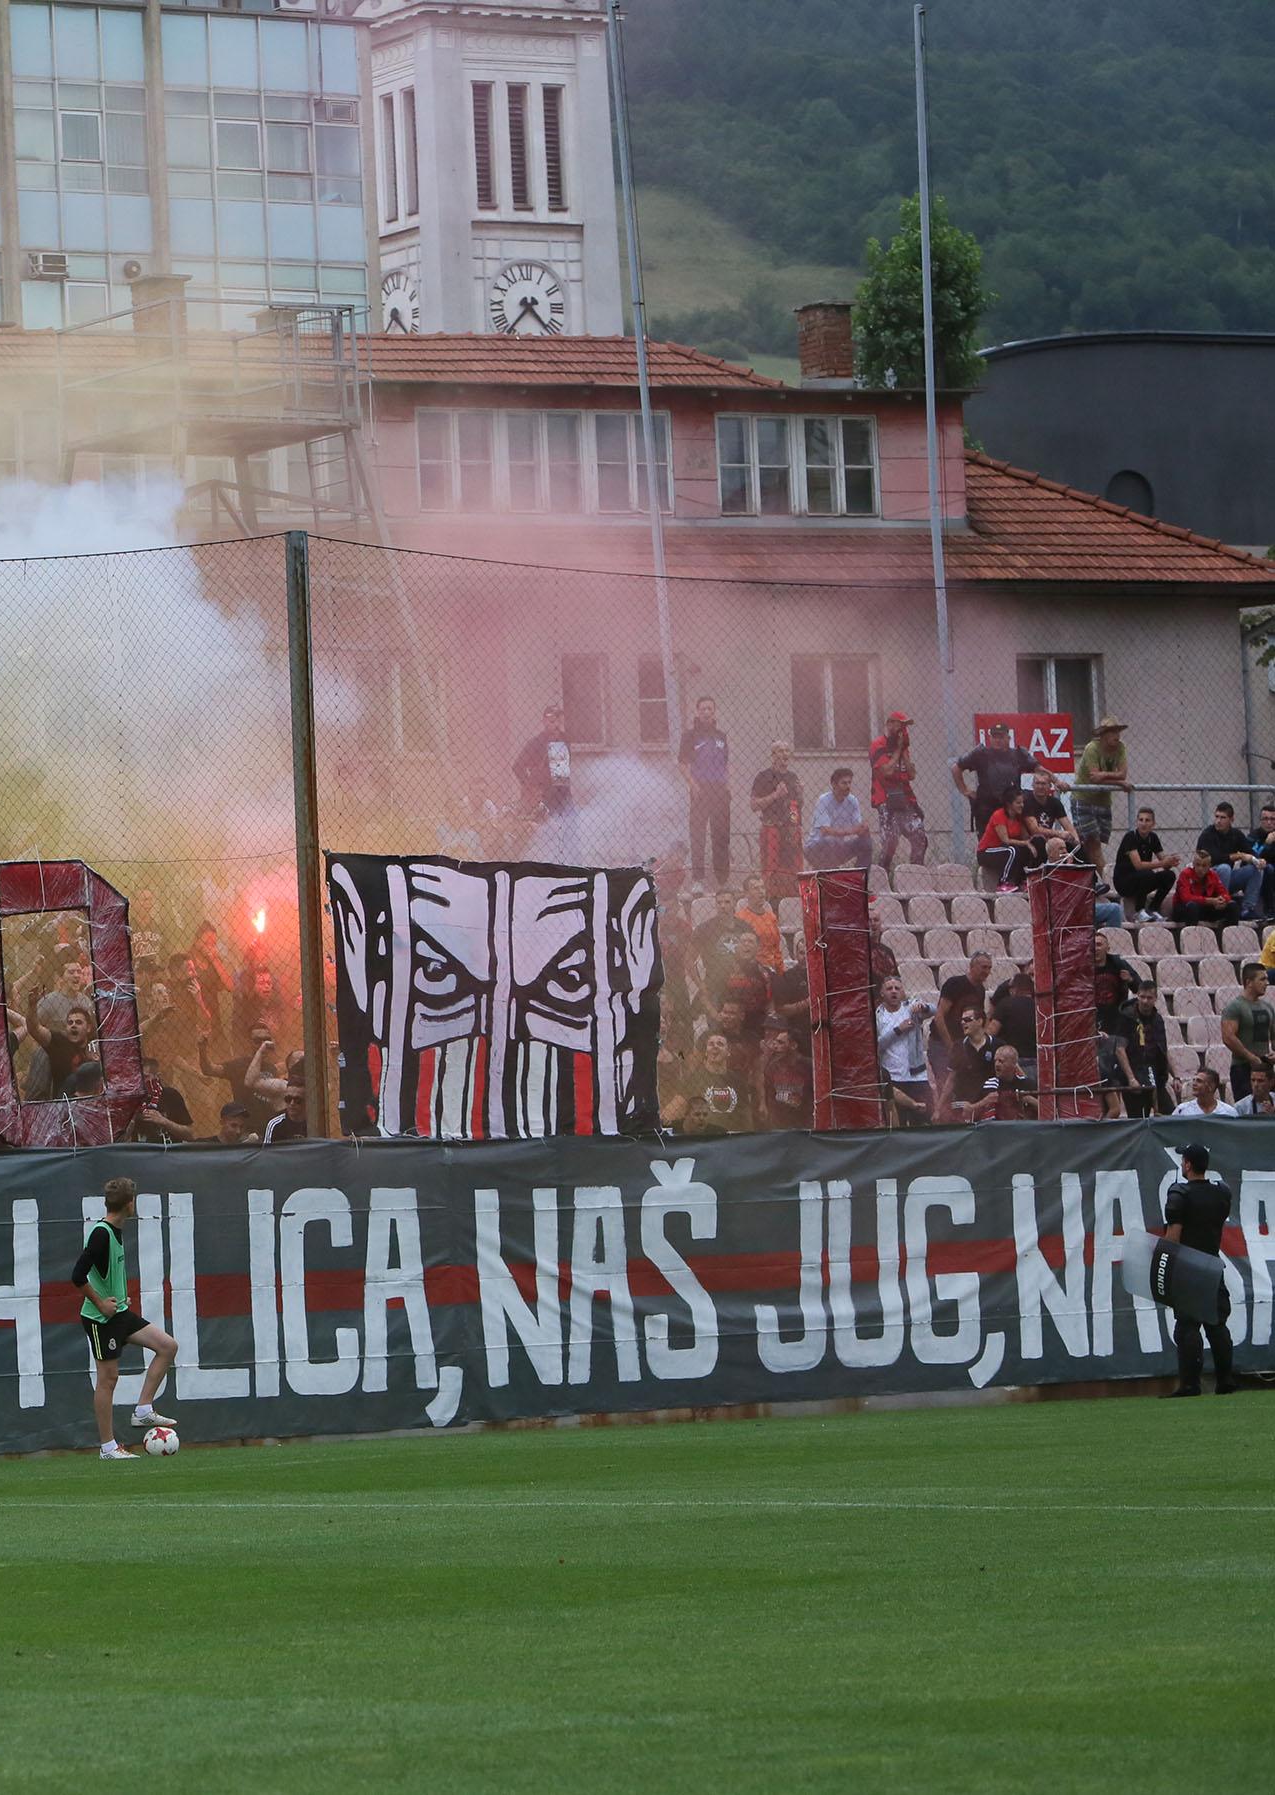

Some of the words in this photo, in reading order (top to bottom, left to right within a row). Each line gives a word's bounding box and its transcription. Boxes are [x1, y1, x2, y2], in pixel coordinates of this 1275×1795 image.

[979, 728, 1071, 758] IAZ
[474, 1158, 718, 1388] NAŠ
[754, 1173, 1005, 1389] JUG,
[1157, 1252, 1170, 1296] CONDOR
